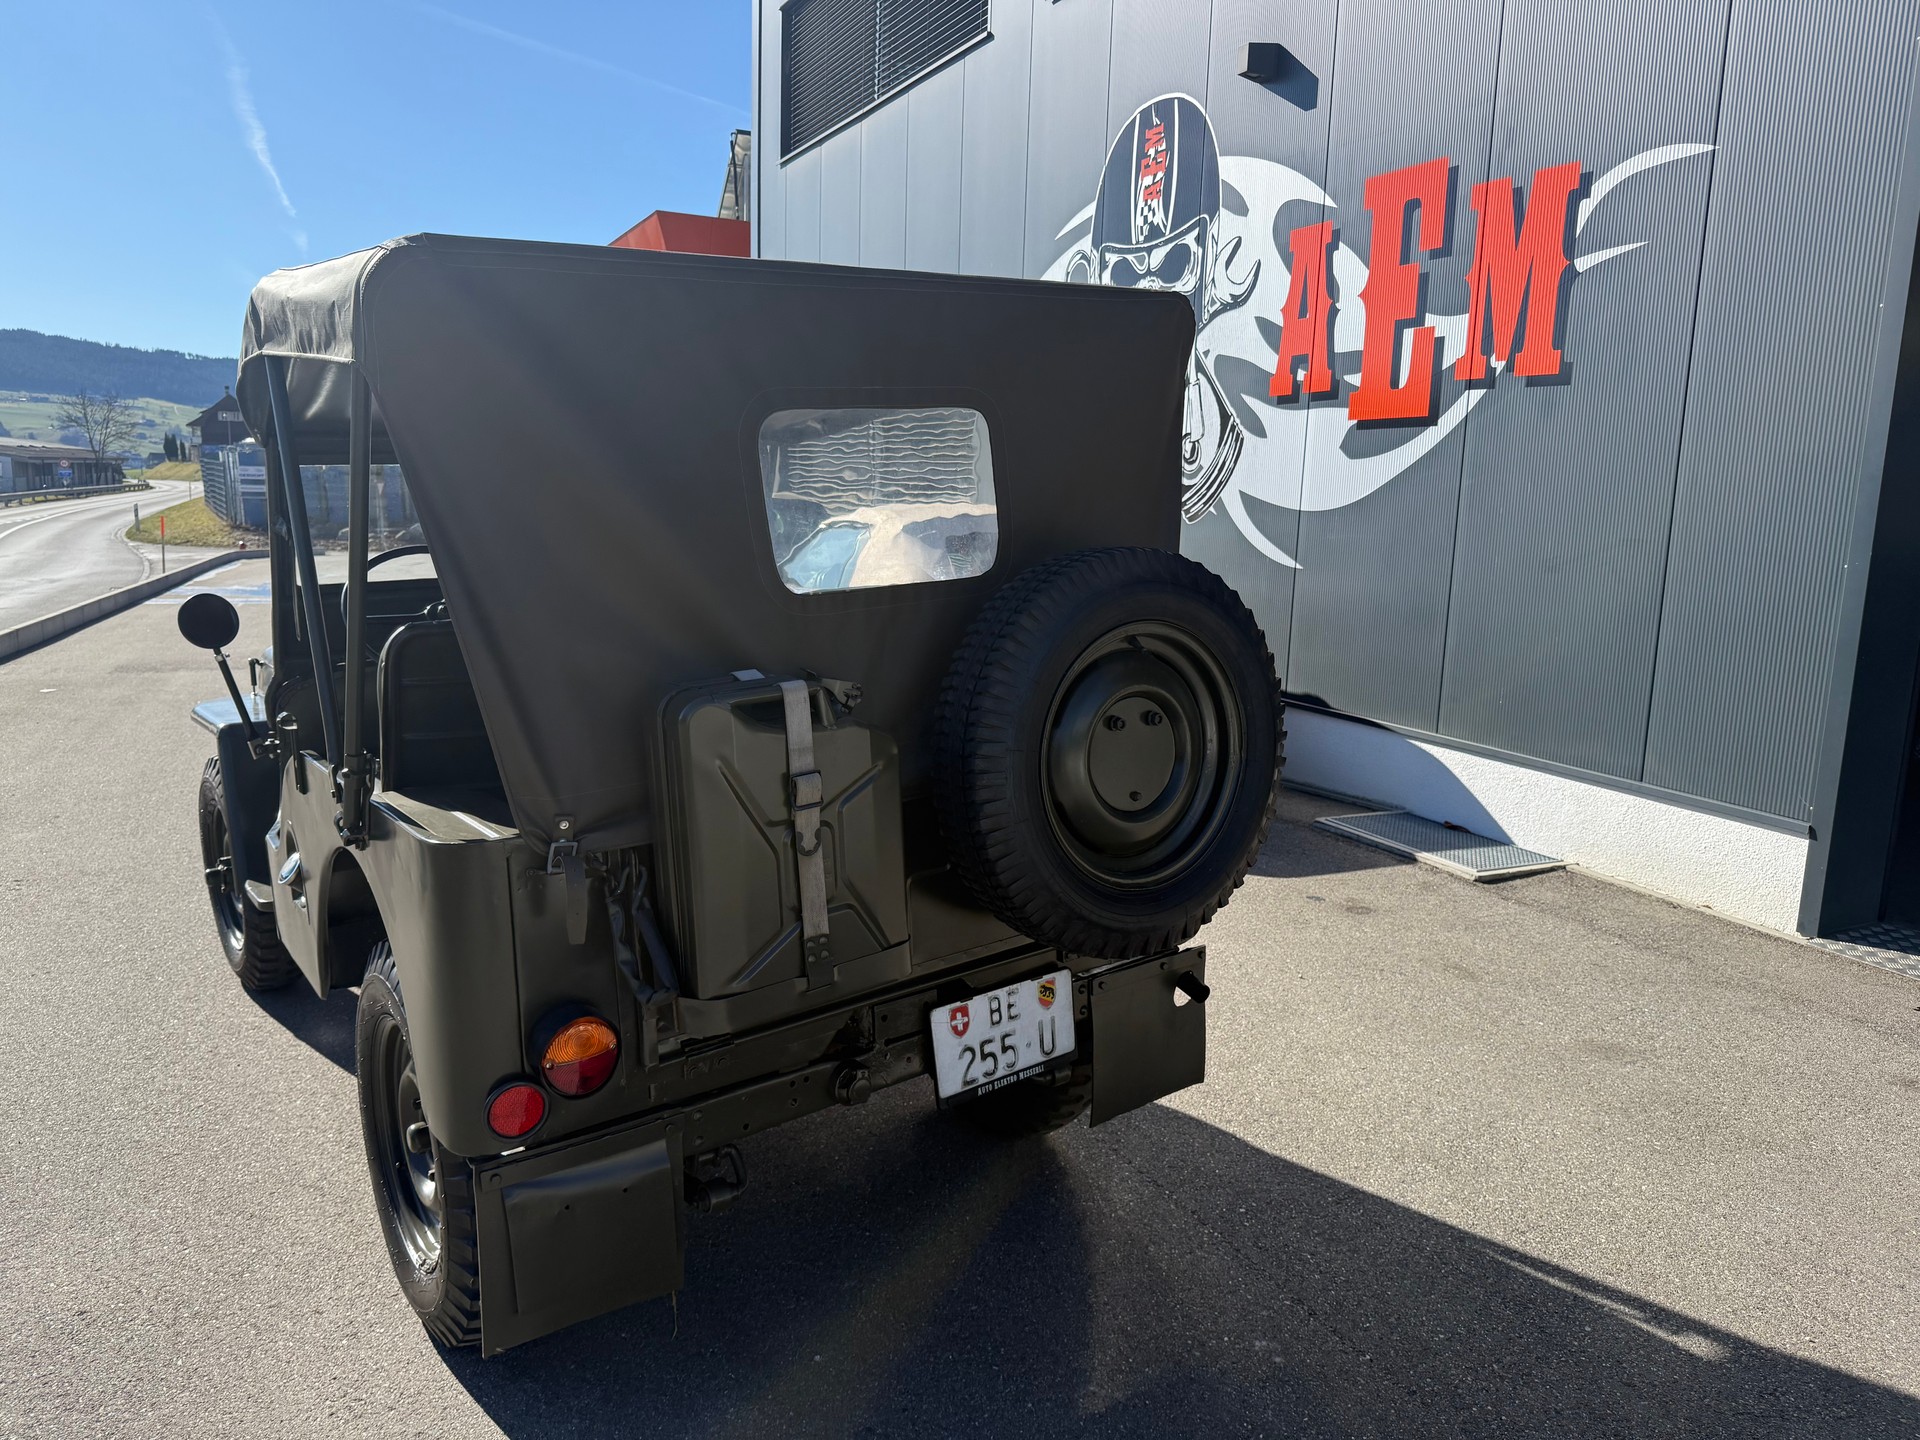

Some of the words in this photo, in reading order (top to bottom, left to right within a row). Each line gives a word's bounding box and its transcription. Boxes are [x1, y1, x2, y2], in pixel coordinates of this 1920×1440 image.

[1141, 122, 1166, 202] AEM
[1269, 156, 1581, 421] AEM
[989, 985, 1021, 1028] BE
[958, 1028, 1019, 1089] 255
[977, 1083, 993, 1097] AUTO
[994, 1074, 1018, 1090] ELEKTRO
[1018, 1064, 1045, 1081] MESSERLI
